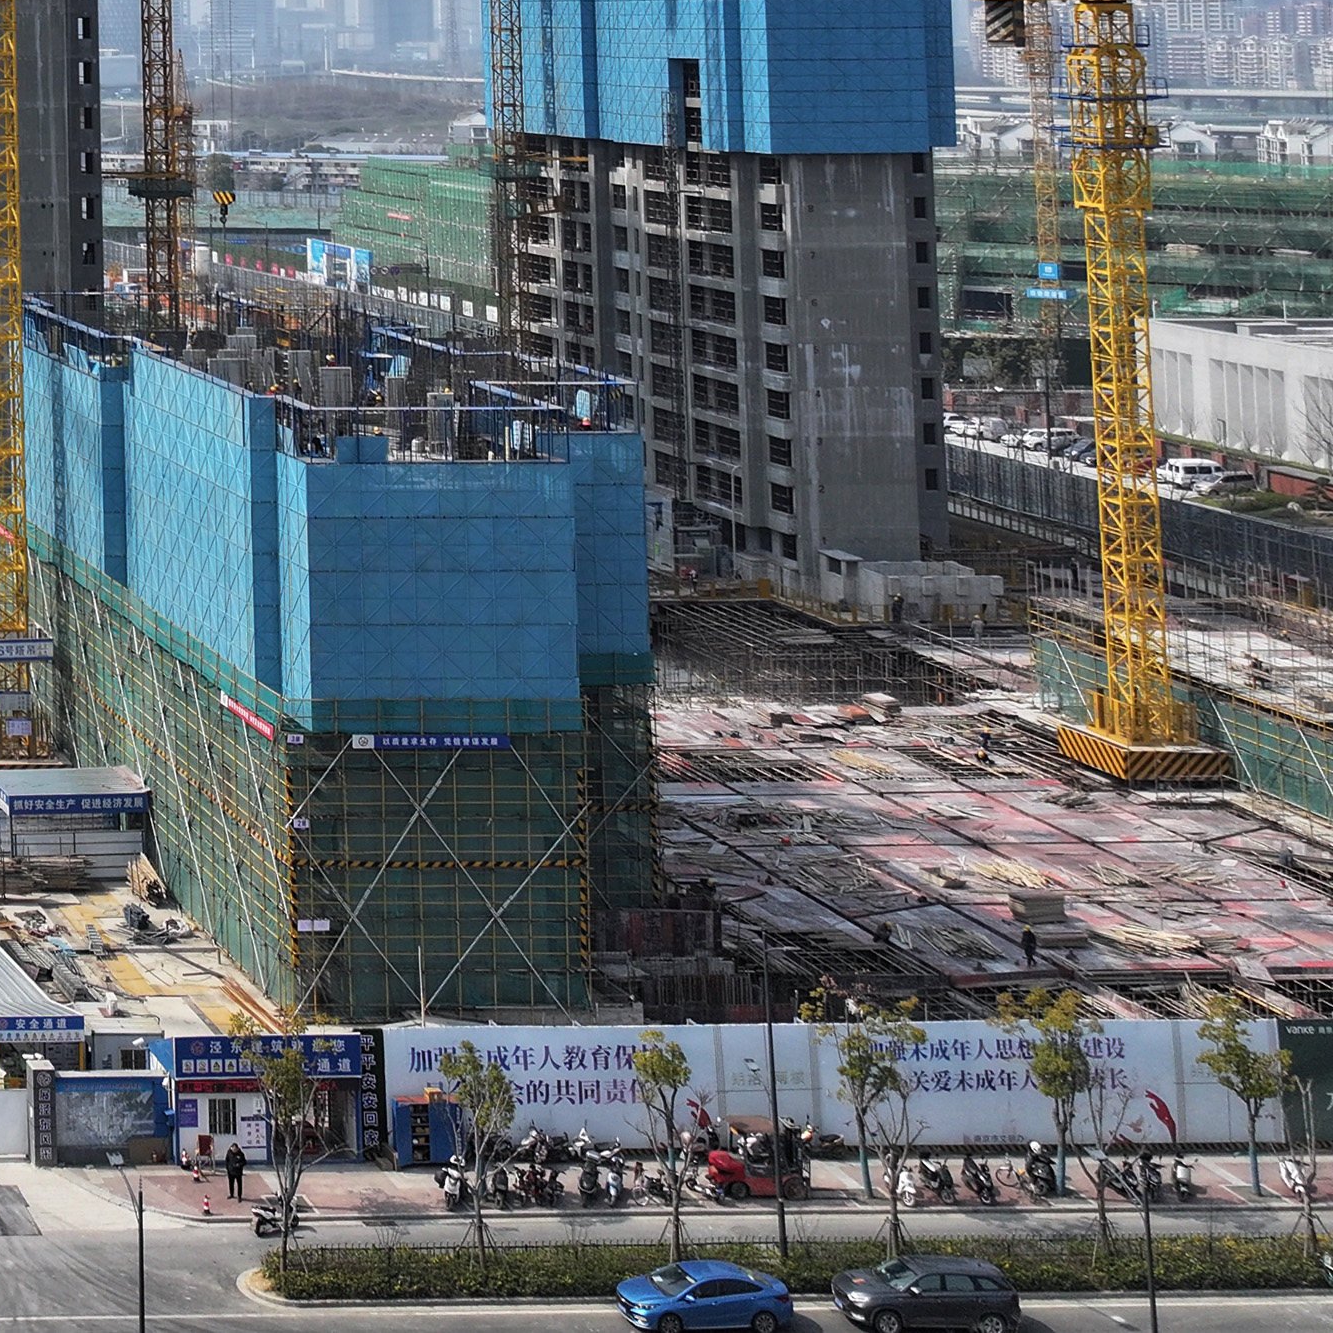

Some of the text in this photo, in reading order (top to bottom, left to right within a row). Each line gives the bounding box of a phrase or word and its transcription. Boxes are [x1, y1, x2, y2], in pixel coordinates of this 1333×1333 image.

[13, 796, 144, 811] 抓好安全生产 促进经济发展
[15, 1018, 67, 1030] 安全通道
[360, 1034, 380, 1147] 平平安安回家
[913, 1068, 1128, 1093] 关爱未成年人成长
